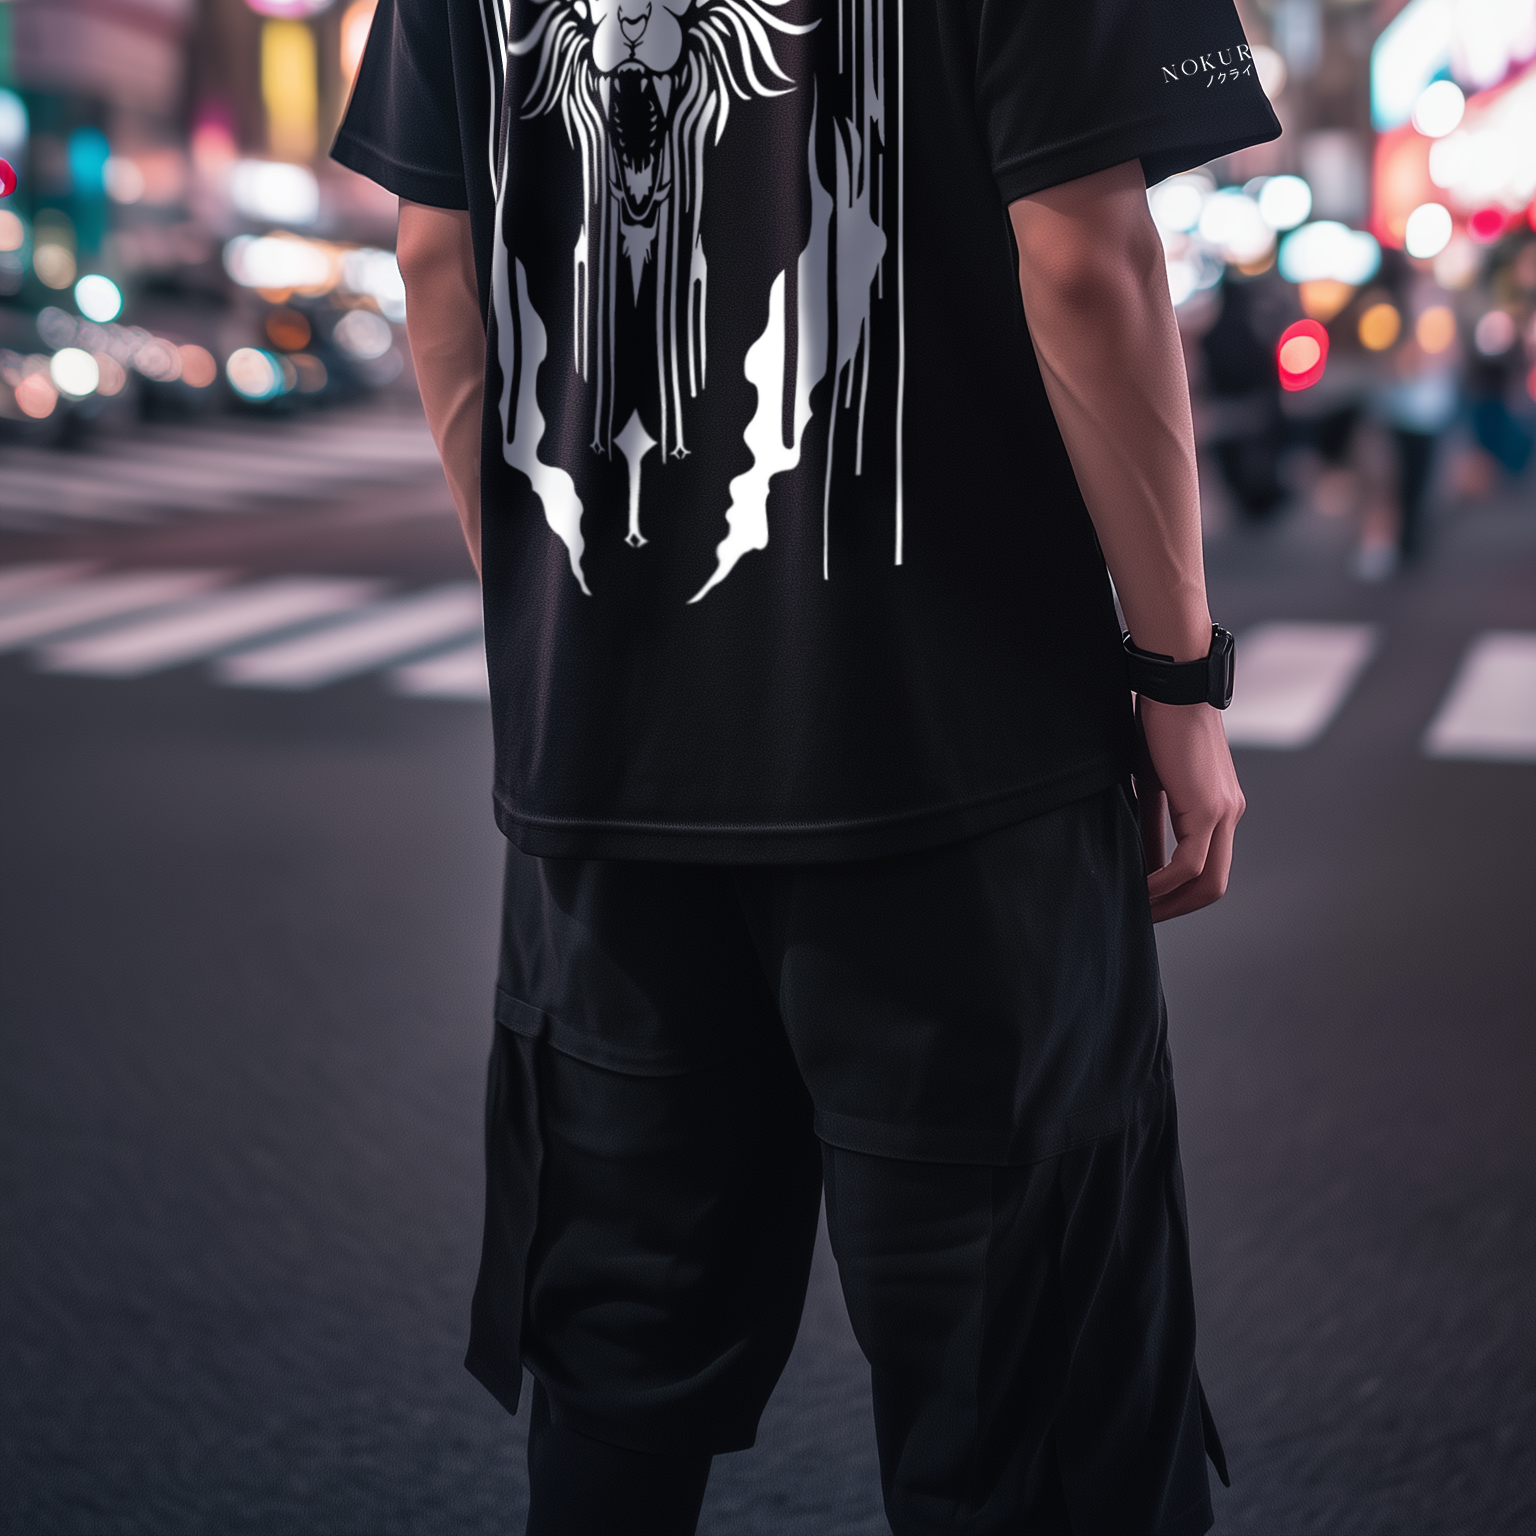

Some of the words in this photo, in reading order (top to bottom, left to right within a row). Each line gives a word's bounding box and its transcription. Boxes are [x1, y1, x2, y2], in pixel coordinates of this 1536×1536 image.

[1161, 43, 1252, 83] NOKUR
[1206, 64, 1252, 88] ノクライ
